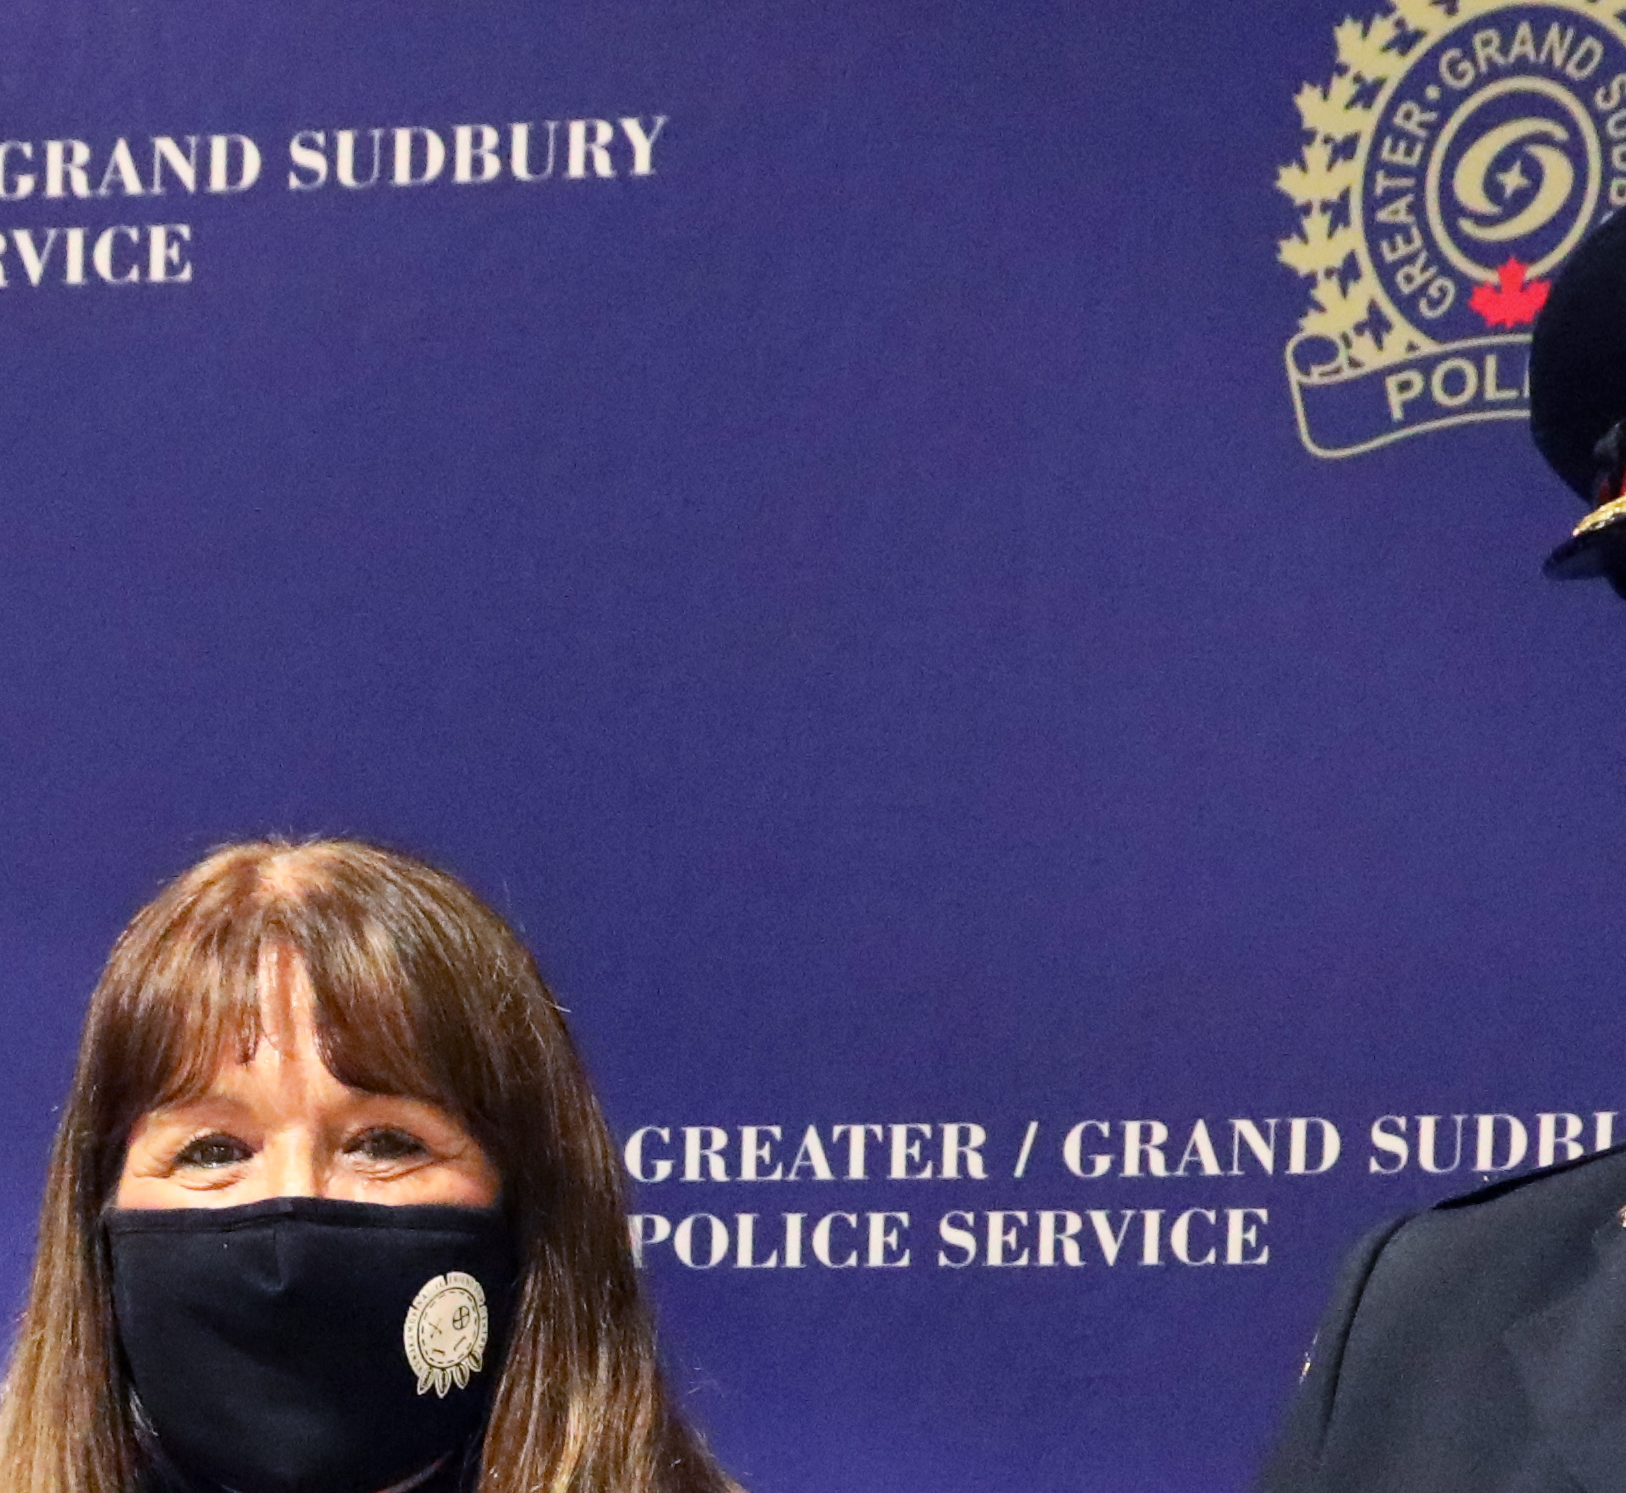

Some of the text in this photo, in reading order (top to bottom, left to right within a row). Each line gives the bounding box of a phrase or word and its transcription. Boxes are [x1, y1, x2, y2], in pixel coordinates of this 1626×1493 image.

[288, 116, 668, 191] SUDBURY
[1374, 99, 1457, 319] GREATER
[1438, 21, 1605, 90] GRAND
[1385, 355, 1529, 422] POL
[623, 1122, 988, 1183] GREATER
[1013, 1120, 1039, 1179] /
[1062, 1117, 1341, 1179] GRAND
[630, 1207, 1269, 1269] POLICE SERVICE
